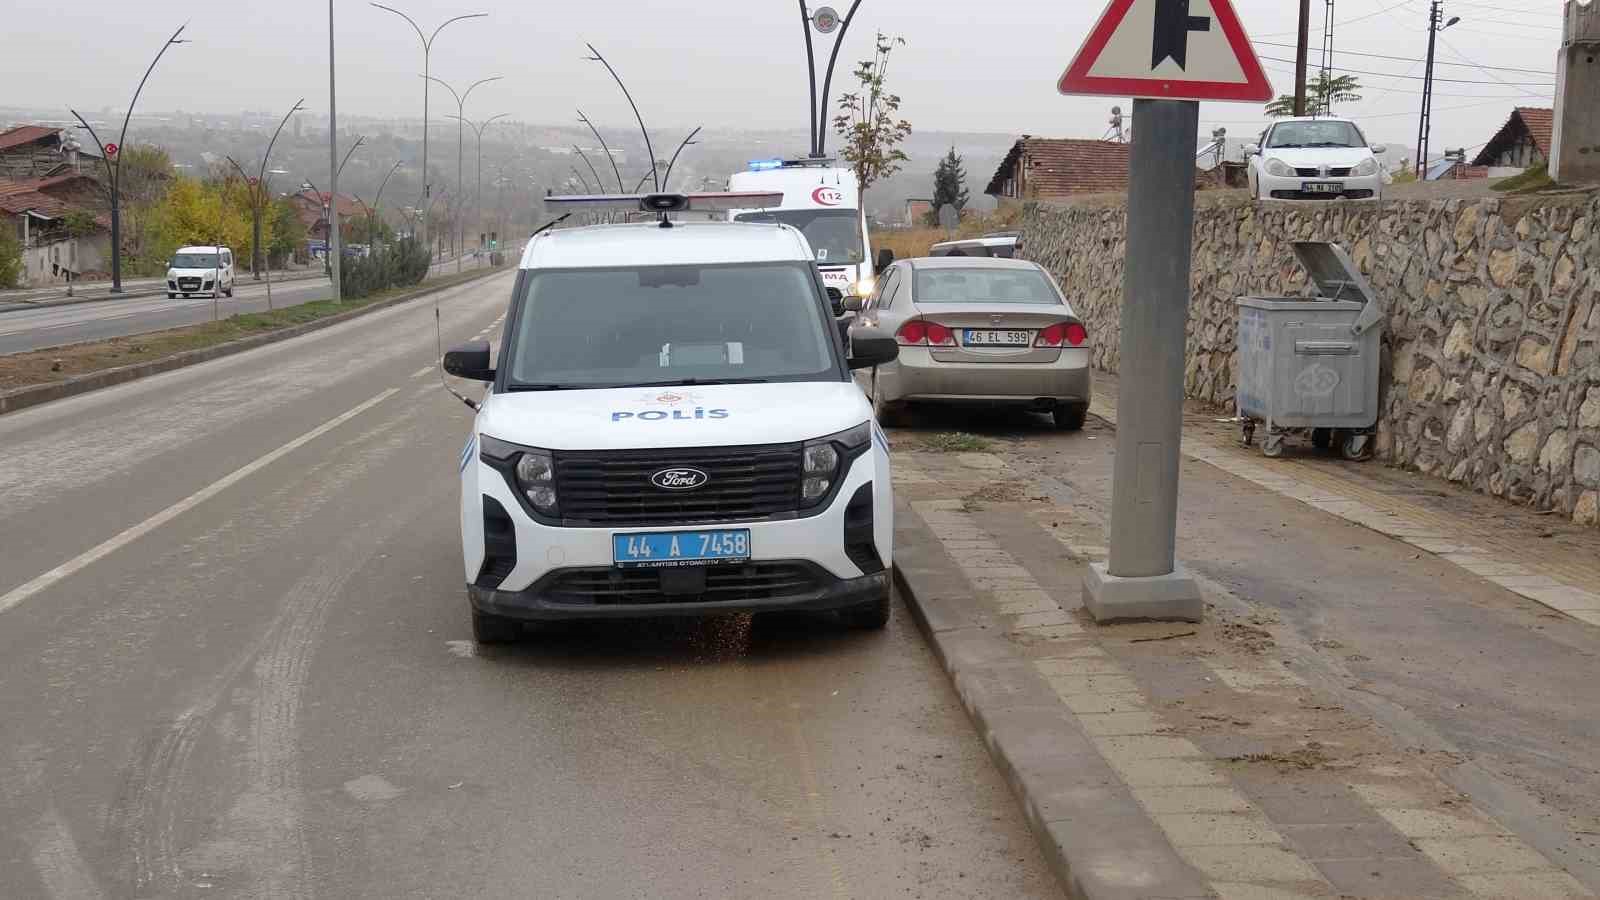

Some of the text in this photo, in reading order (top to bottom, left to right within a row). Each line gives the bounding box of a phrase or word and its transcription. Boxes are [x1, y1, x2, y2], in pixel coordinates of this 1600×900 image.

[820, 192, 842, 201] 112
[969, 332, 1027, 343] 46 EL 599
[662, 471, 697, 485] Ford
[627, 533, 746, 558] 44 A 7458
